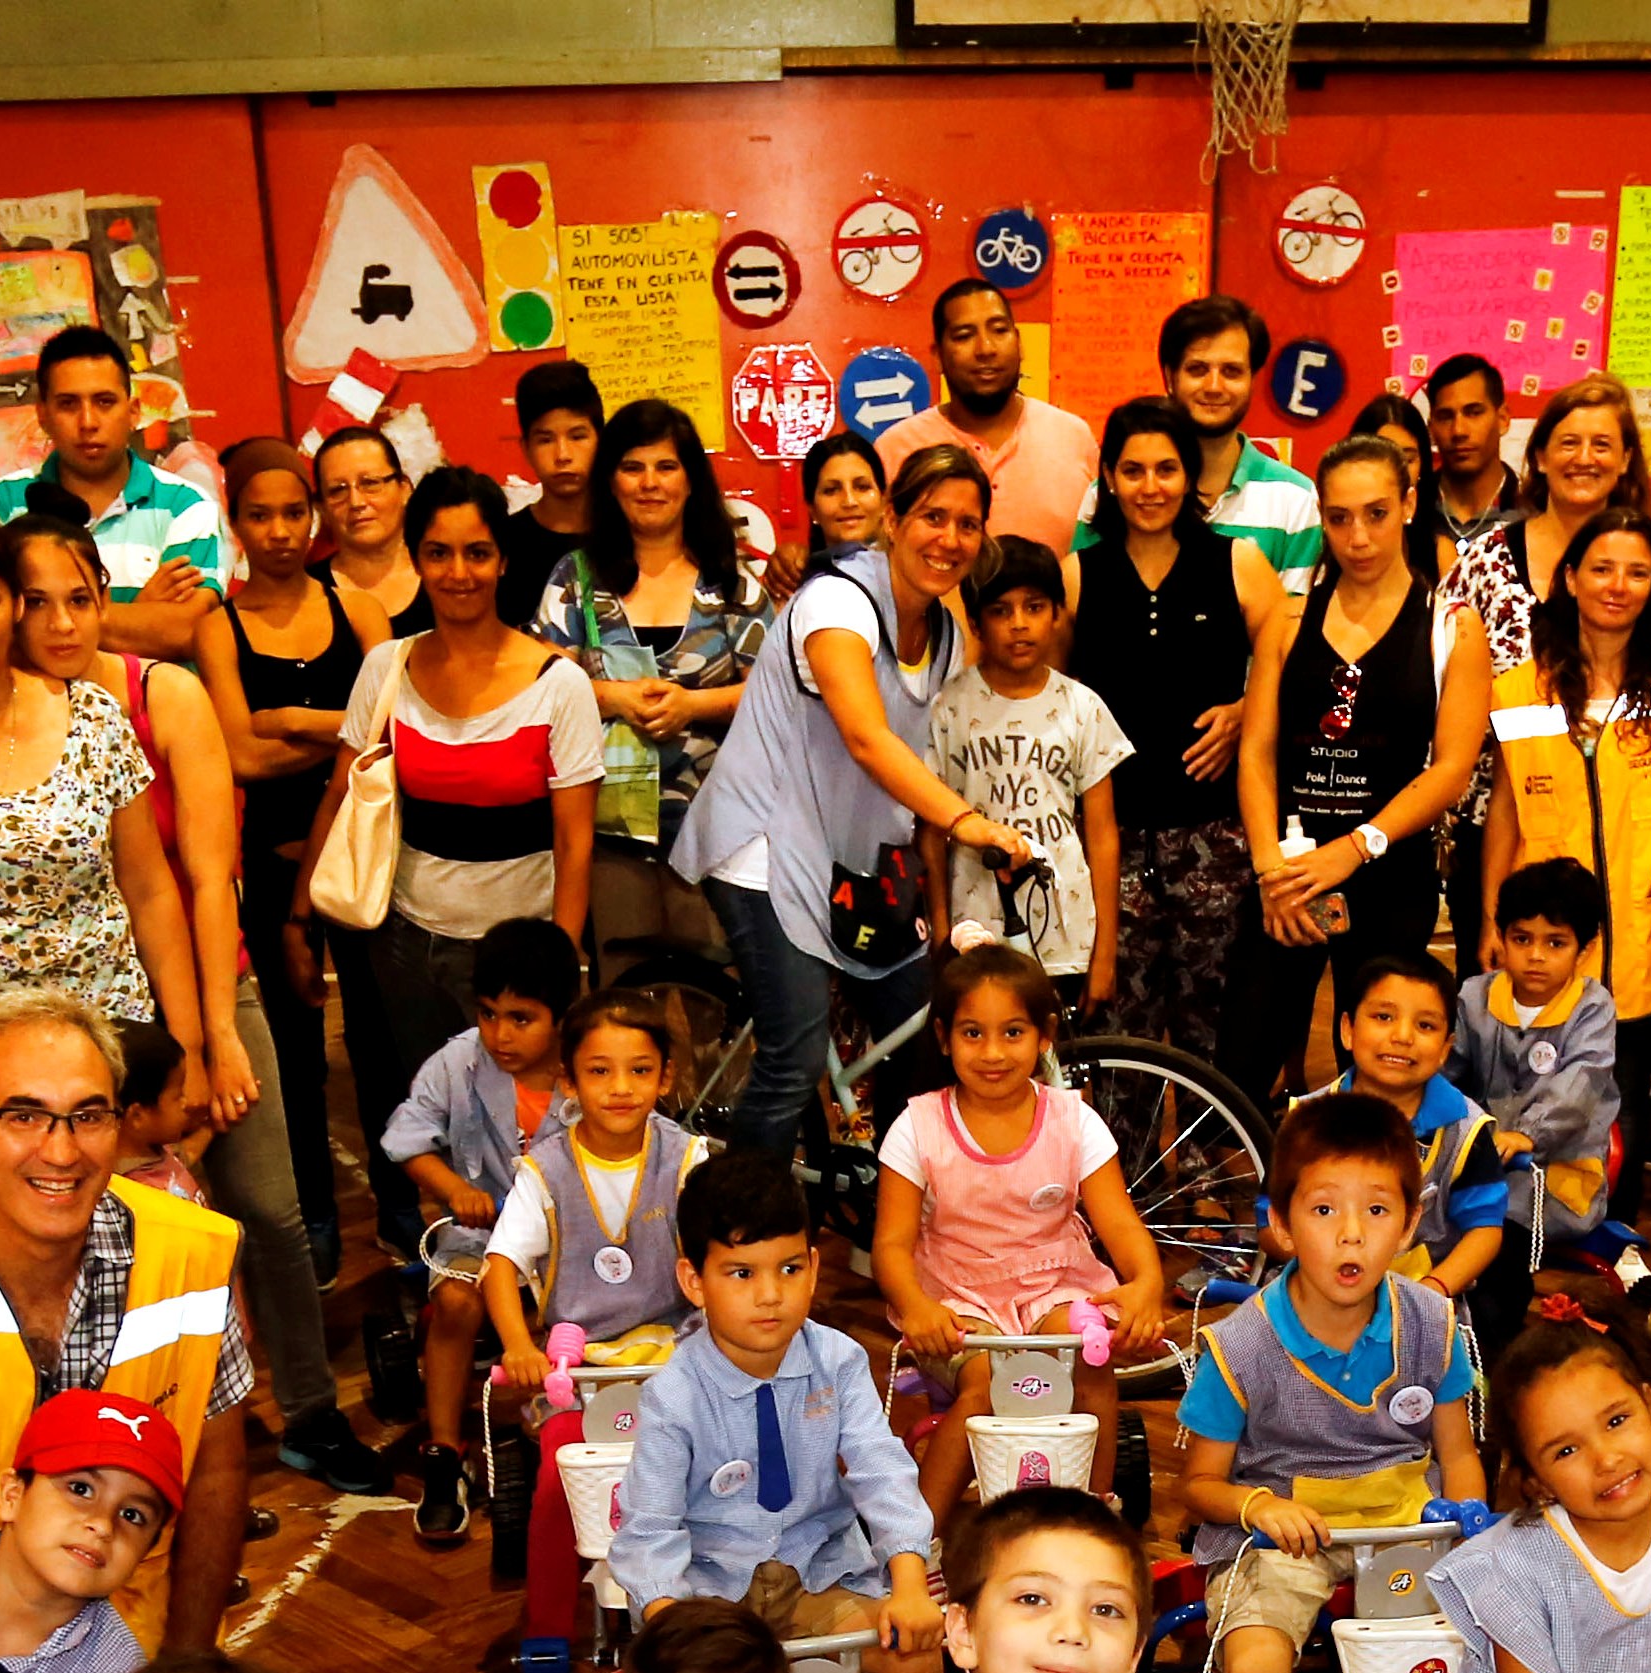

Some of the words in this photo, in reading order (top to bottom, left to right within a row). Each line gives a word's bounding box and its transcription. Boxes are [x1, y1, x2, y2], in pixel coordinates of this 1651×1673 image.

[572, 229, 591, 248] SI
[571, 249, 700, 270] AUTOMOVILISTA
[617, 276, 637, 290] EN
[648, 270, 708, 288] CUENTA
[584, 295, 619, 308] ESTA
[1287, 349, 1328, 418] E
[739, 385, 828, 424] PARE
[950, 735, 1076, 787] VINTAGE
[1310, 746, 1358, 759] STUDIO
[1306, 771, 1327, 783] Pole
[1335, 773, 1367, 785] Dance
[990, 773, 1038, 811] NYC
